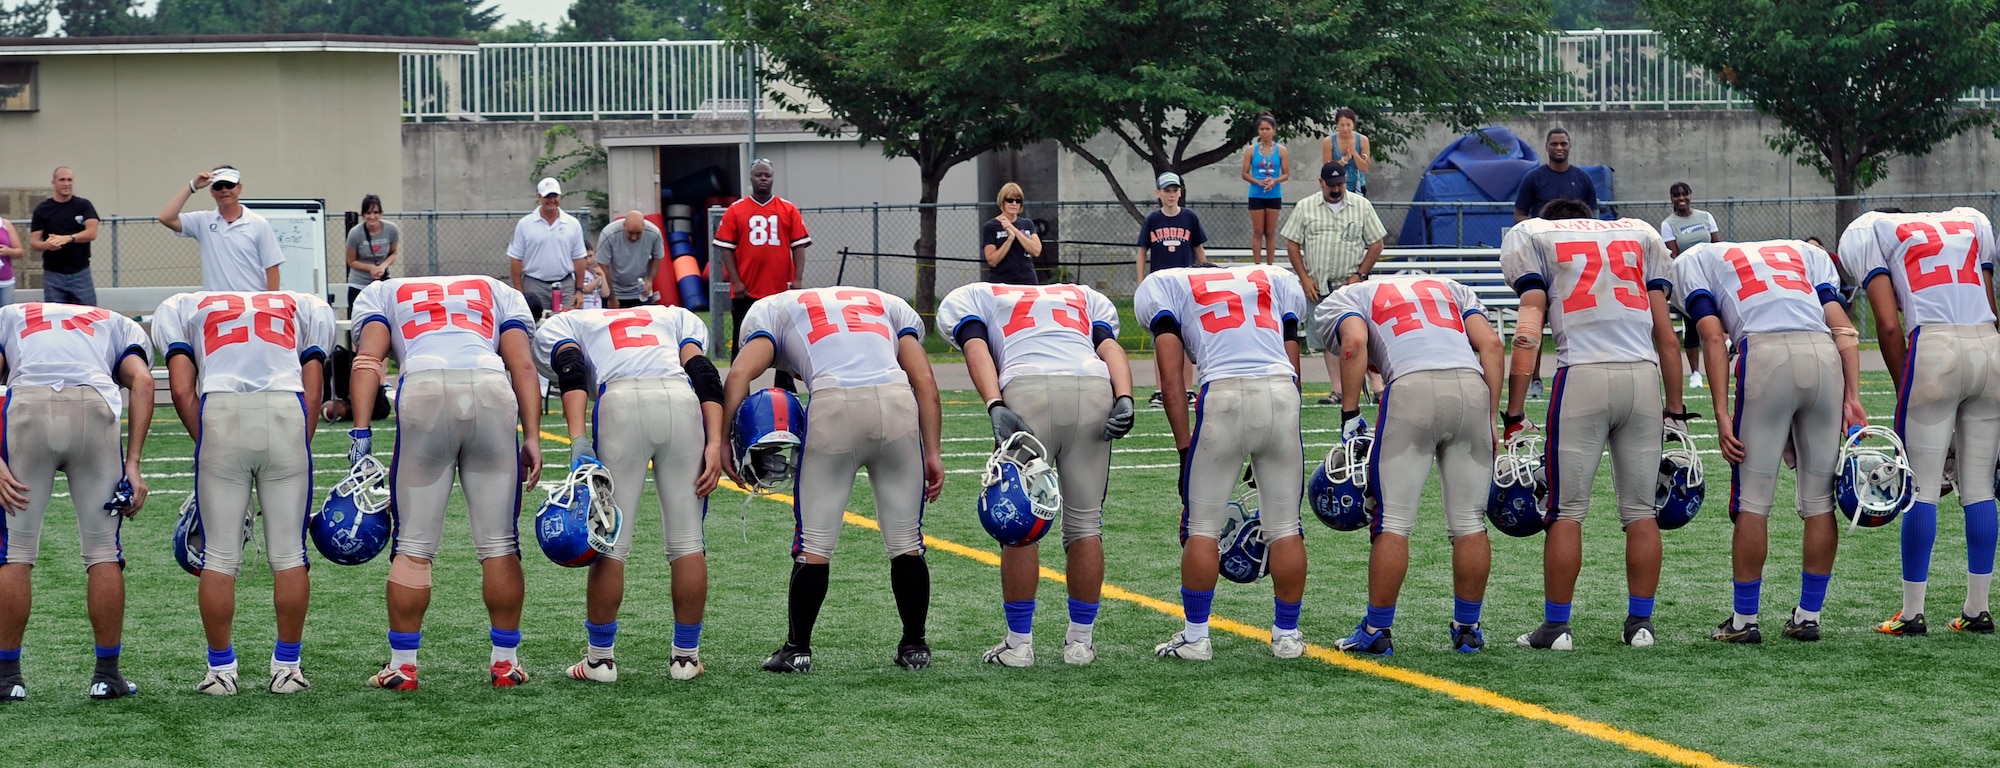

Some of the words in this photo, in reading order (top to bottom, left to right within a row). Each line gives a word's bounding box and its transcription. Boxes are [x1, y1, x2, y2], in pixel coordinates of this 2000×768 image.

[749, 215, 780, 245] 81
[1150, 227, 1190, 242] AUBURN
[1895, 222, 1981, 293] 27
[1187, 270, 1280, 334] 51
[1554, 240, 1656, 315] 79
[1723, 245, 1813, 302] 19
[198, 293, 296, 355] 28
[396, 279, 495, 340] 33
[602, 309, 660, 351] 2
[797, 290, 891, 345] 12
[991, 285, 1090, 337] 73
[1371, 279, 1465, 337] 40
